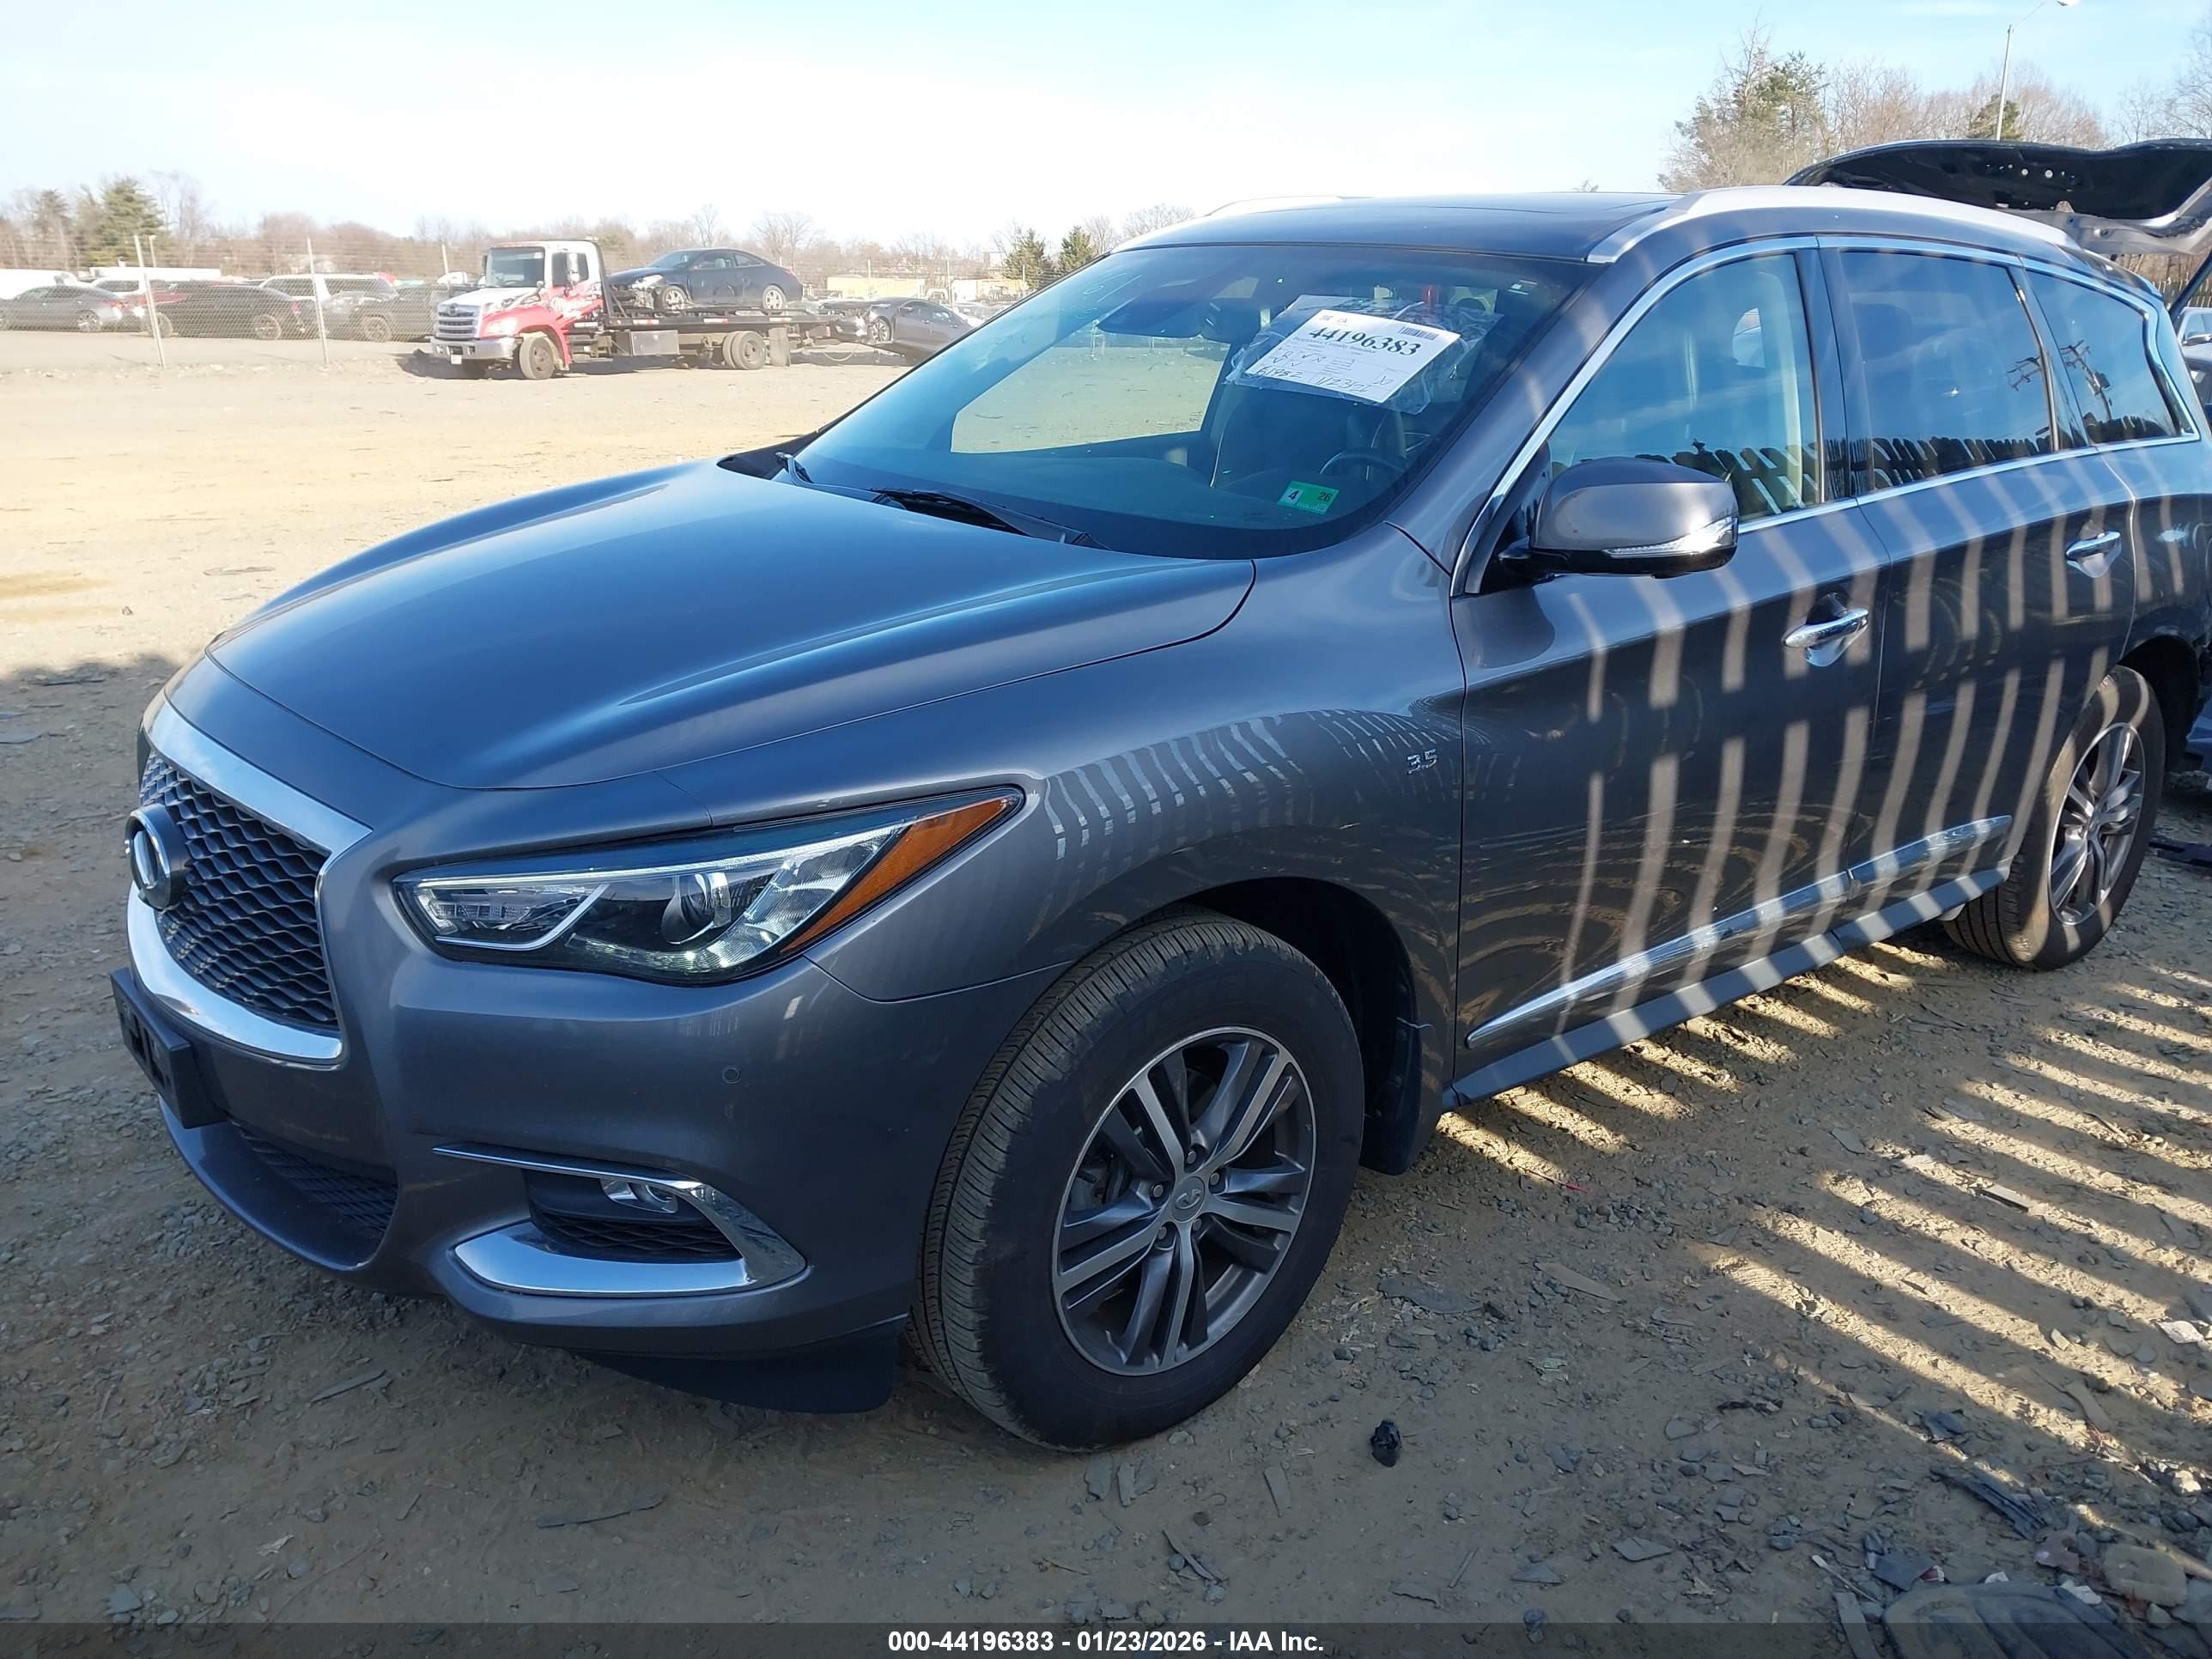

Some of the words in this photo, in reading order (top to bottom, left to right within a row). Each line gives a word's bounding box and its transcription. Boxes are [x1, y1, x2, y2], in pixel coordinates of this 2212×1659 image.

[1310, 326, 1422, 356] 44196383
[1288, 490, 1299, 501] 4
[1317, 491, 1333, 502] 26
